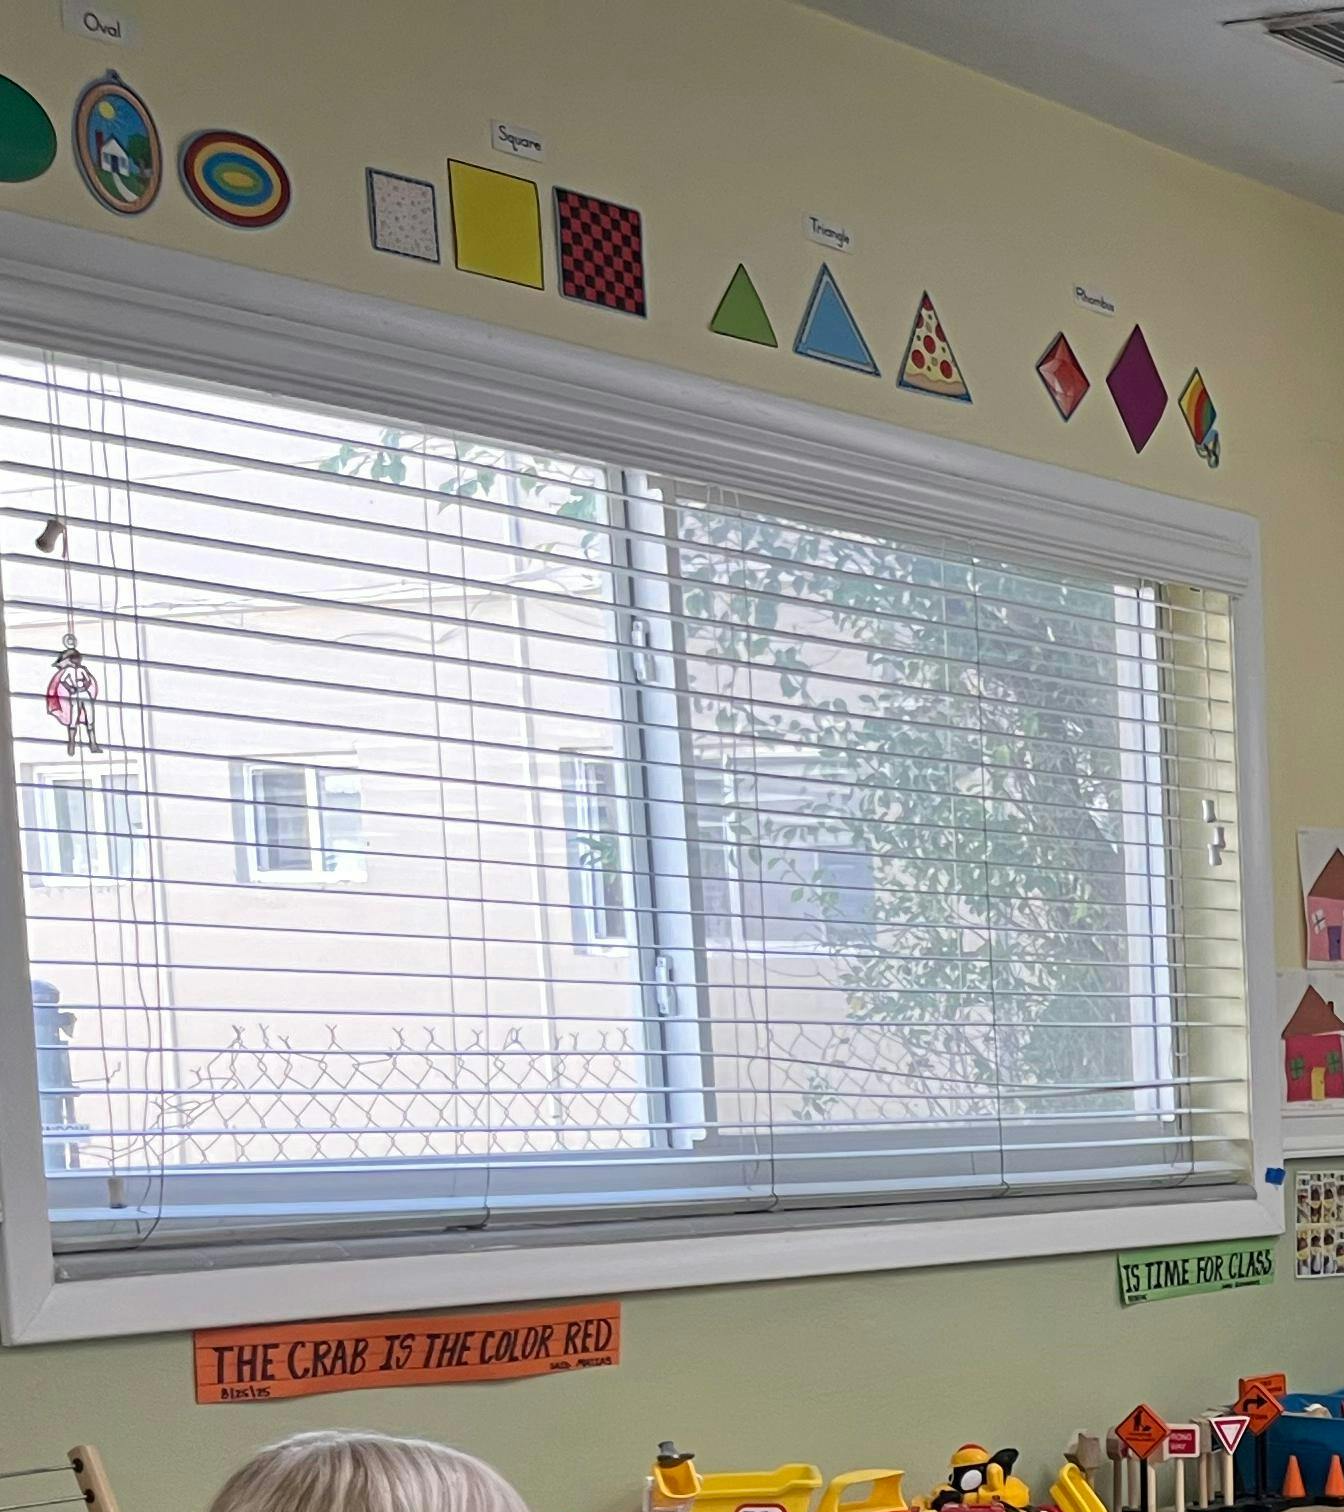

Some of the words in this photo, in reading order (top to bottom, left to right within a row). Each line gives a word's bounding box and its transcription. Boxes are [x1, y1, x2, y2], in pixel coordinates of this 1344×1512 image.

[83, 12, 122, 39] Oval
[497, 124, 542, 152] Square
[808, 216, 851, 248] Triangle
[1122, 1264, 1140, 1293] IS
[1145, 1259, 1189, 1290] TIME
[1197, 1255, 1223, 1283] FOR
[1229, 1249, 1272, 1279] CLASS
[212, 1343, 279, 1384] THE
[288, 1339, 368, 1381] CRAB
[379, 1333, 416, 1372] IS
[423, 1330, 472, 1369] THE
[480, 1325, 553, 1364] COLOR
[564, 1318, 613, 1355] RED
